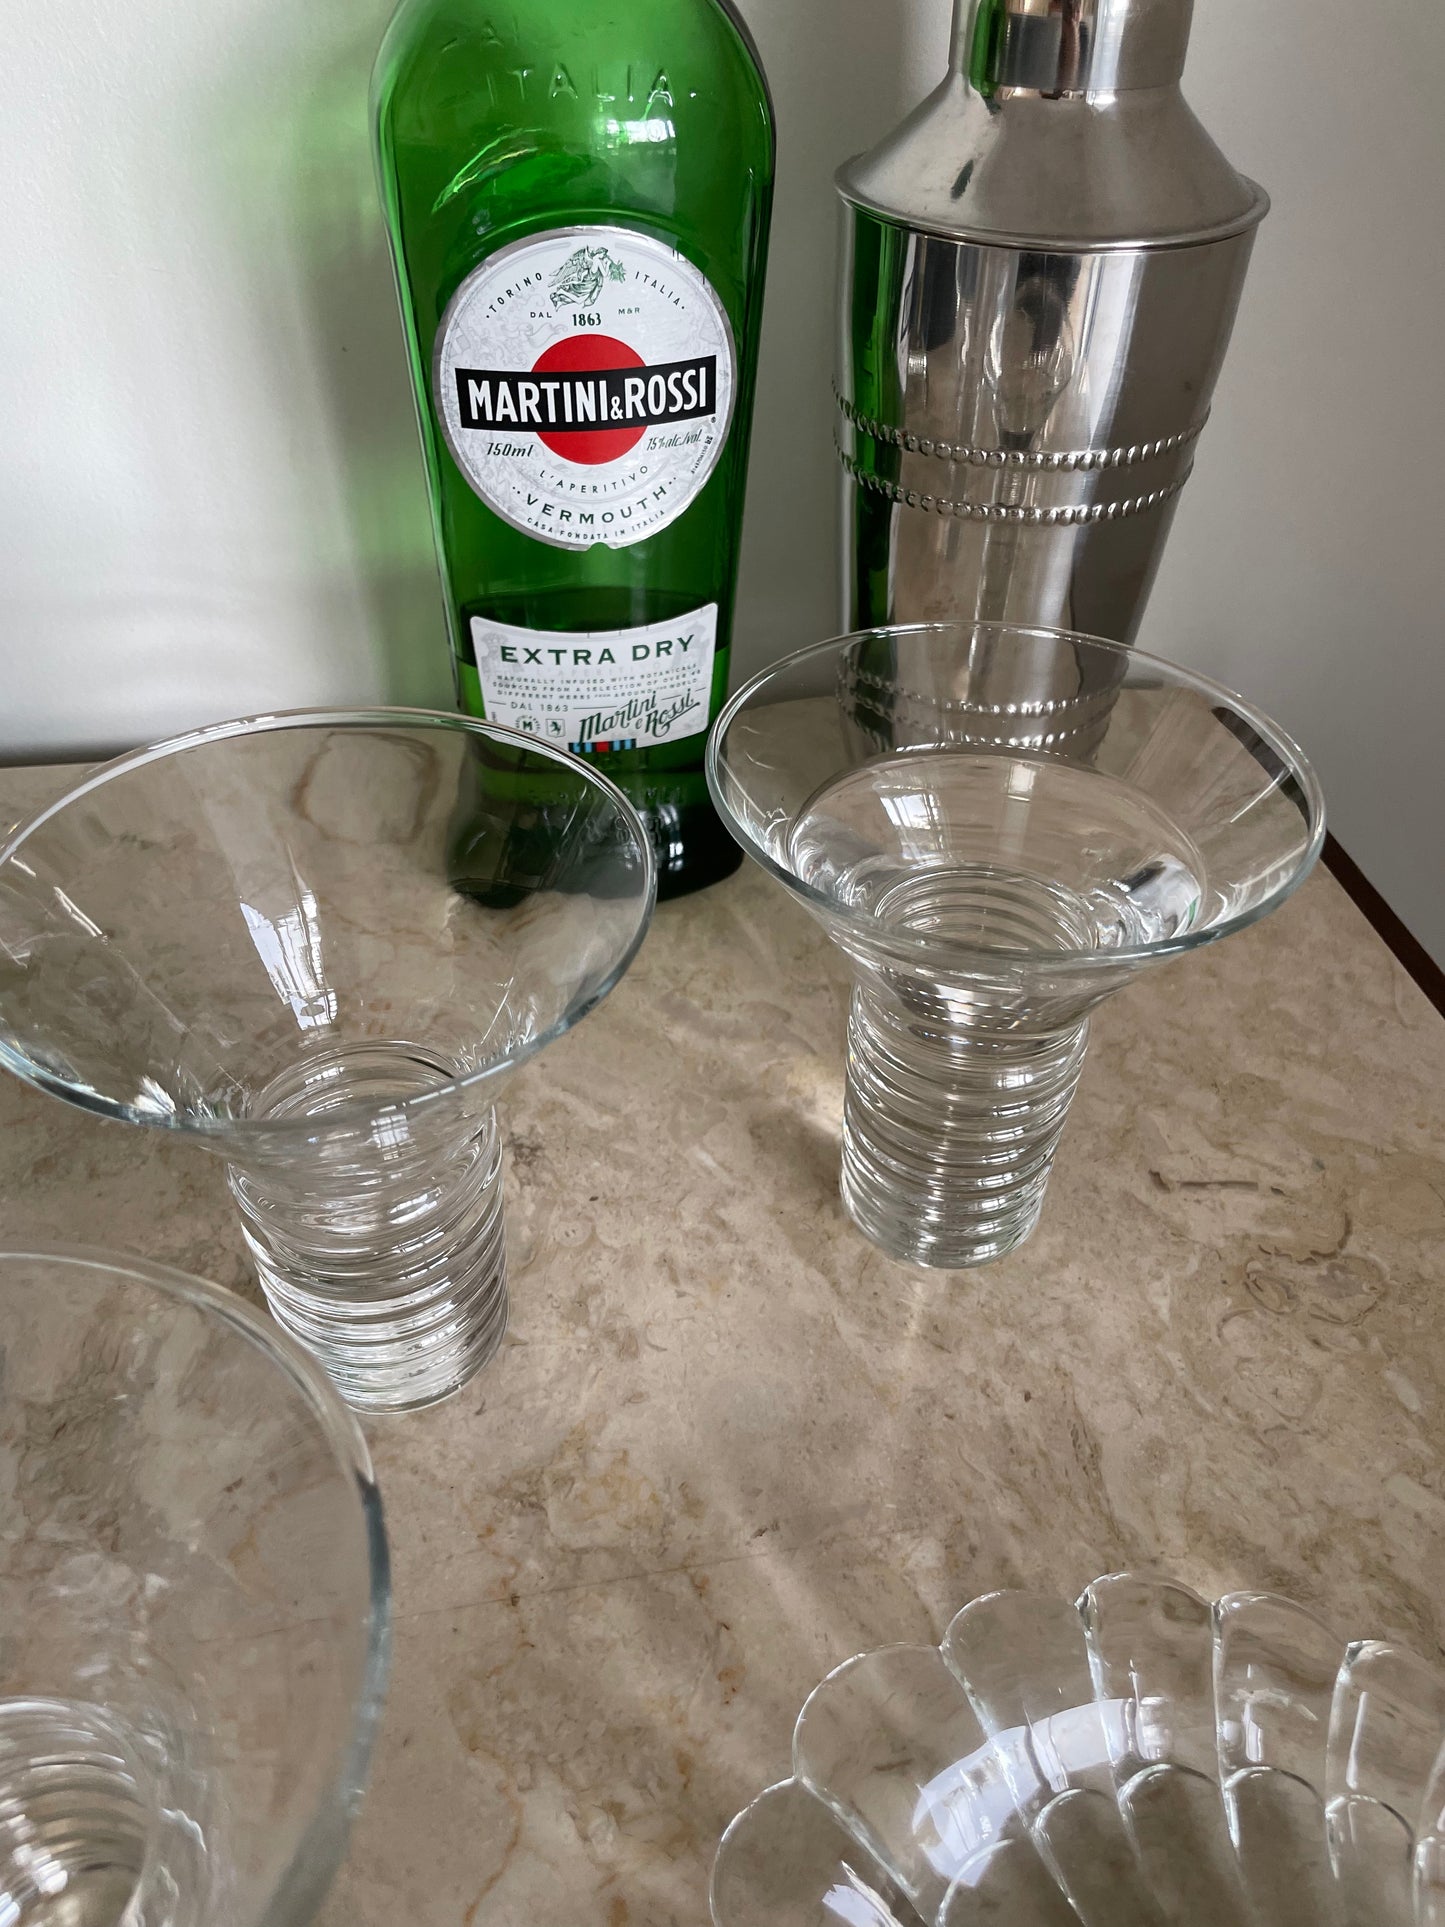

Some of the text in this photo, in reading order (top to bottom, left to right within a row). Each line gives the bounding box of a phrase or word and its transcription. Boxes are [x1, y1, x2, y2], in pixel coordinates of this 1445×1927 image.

[489, 271, 682, 314] TORINO ITALIA
[530, 311, 552, 319] DAL
[572, 313, 602, 327] 1863
[526, 485, 668, 525] VERMOUTH
[527, 510, 666, 541] CASA FONDATA IN ITALIA
[500, 634, 695, 665] EXTRA DRY
[511, 701, 569, 712] DAL 1863
[579, 690, 657, 746] Martini
[635, 688, 701, 738] e Rossi
